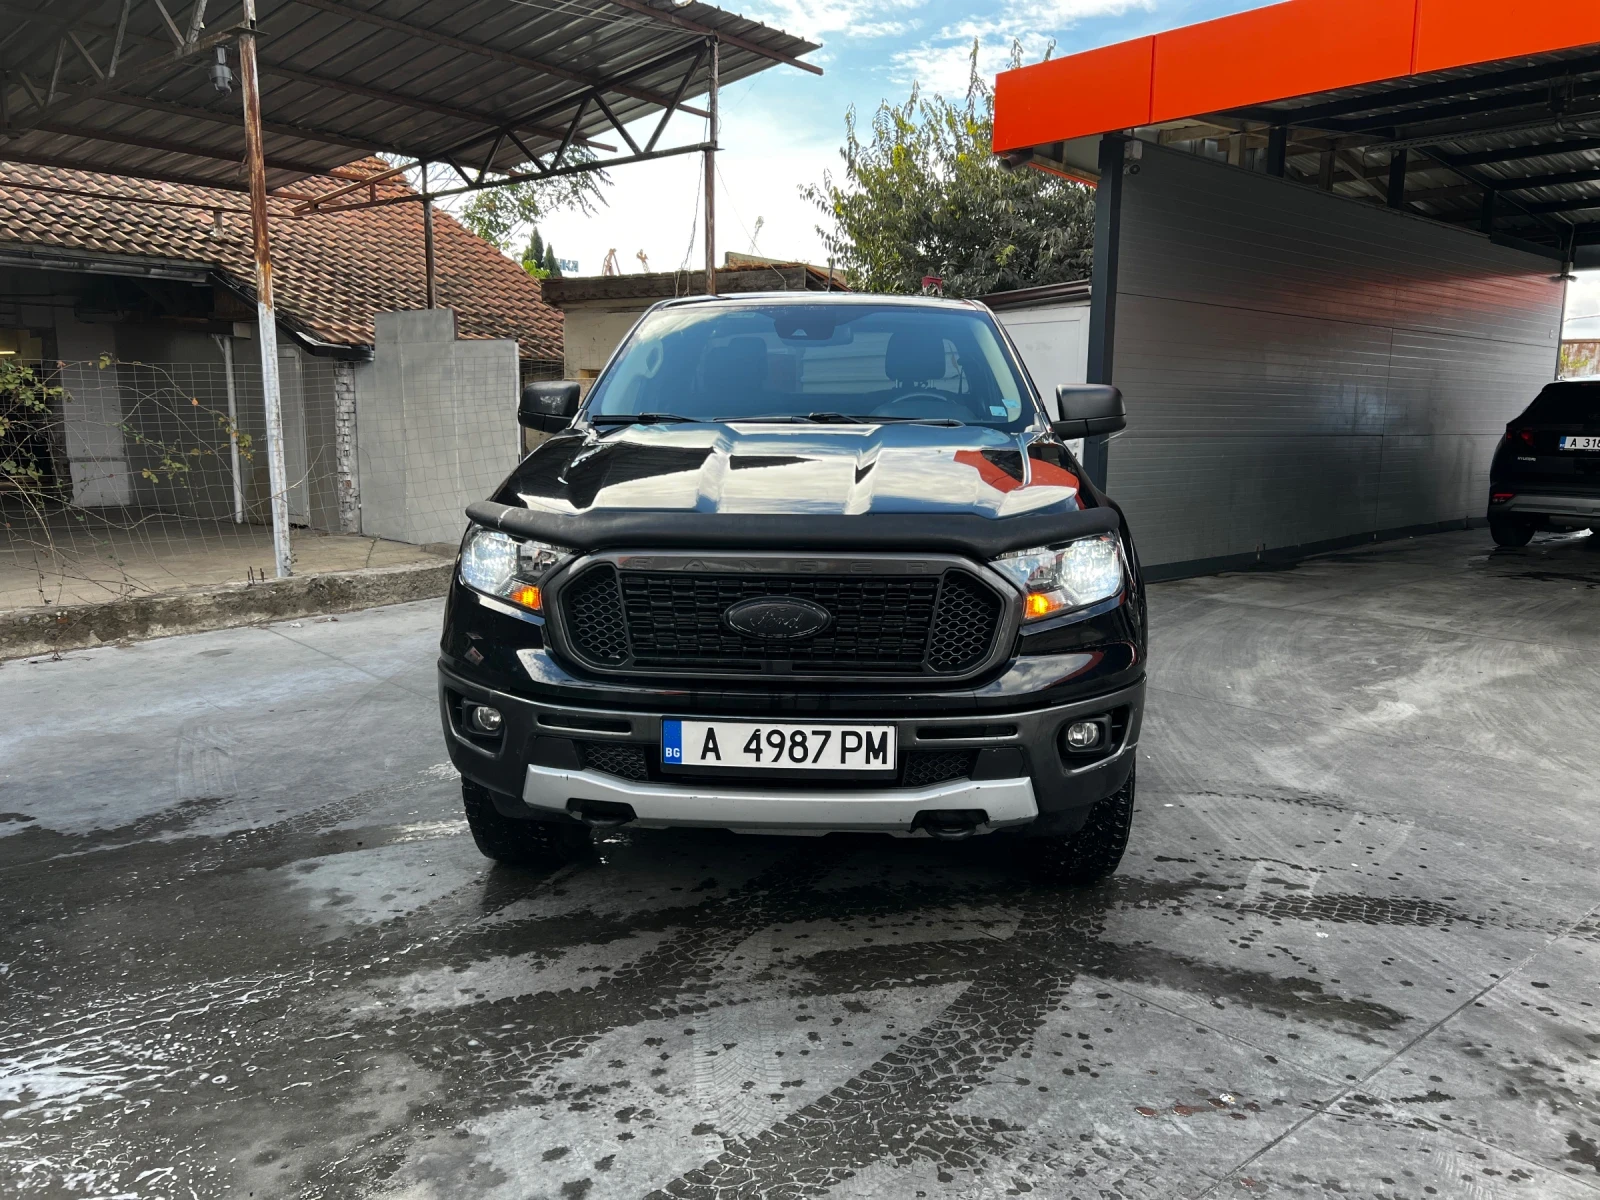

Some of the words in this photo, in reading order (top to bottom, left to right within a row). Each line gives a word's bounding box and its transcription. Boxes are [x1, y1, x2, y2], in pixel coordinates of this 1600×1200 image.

[1570, 438, 1577, 448] A
[631, 557, 928, 573] RANGER
[749, 607, 803, 629] Ford
[665, 747, 680, 758] BG
[700, 727, 722, 761] A
[743, 728, 832, 764] 4987
[840, 730, 888, 765] PM
